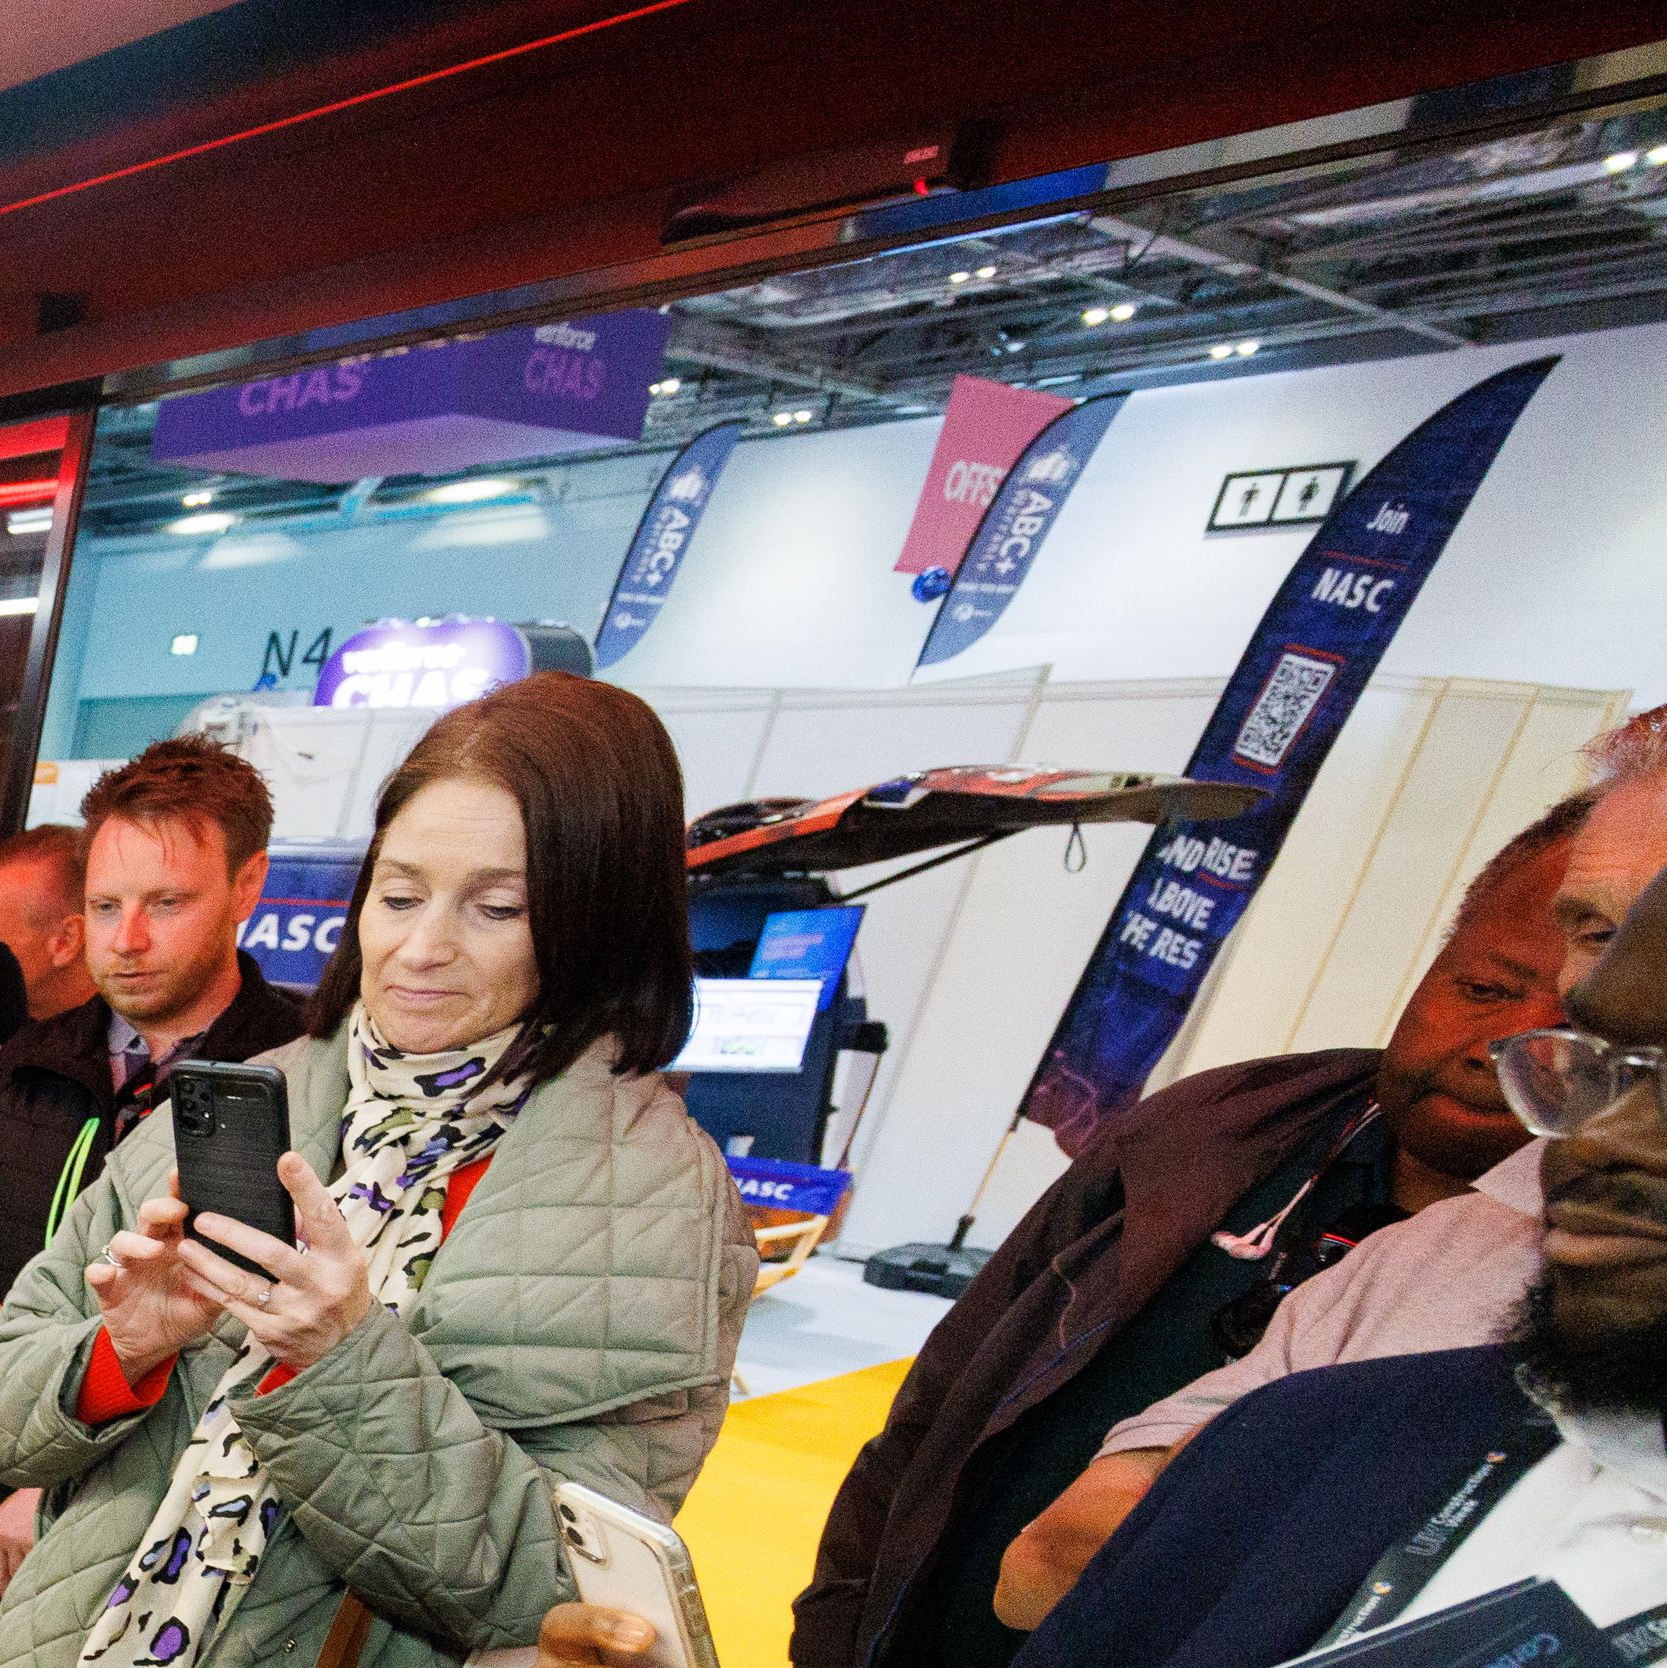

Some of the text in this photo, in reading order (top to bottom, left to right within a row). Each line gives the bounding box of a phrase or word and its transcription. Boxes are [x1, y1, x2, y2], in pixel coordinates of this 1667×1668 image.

[238, 364, 363, 416] CHAS
[525, 348, 607, 401] CHAS
[993, 490, 1054, 576] ABC+
[1366, 501, 1411, 534] Join
[1311, 567, 1395, 613] NASC
[1202, 836, 1259, 881] RISE
[1120, 911, 1204, 969] HE RES
